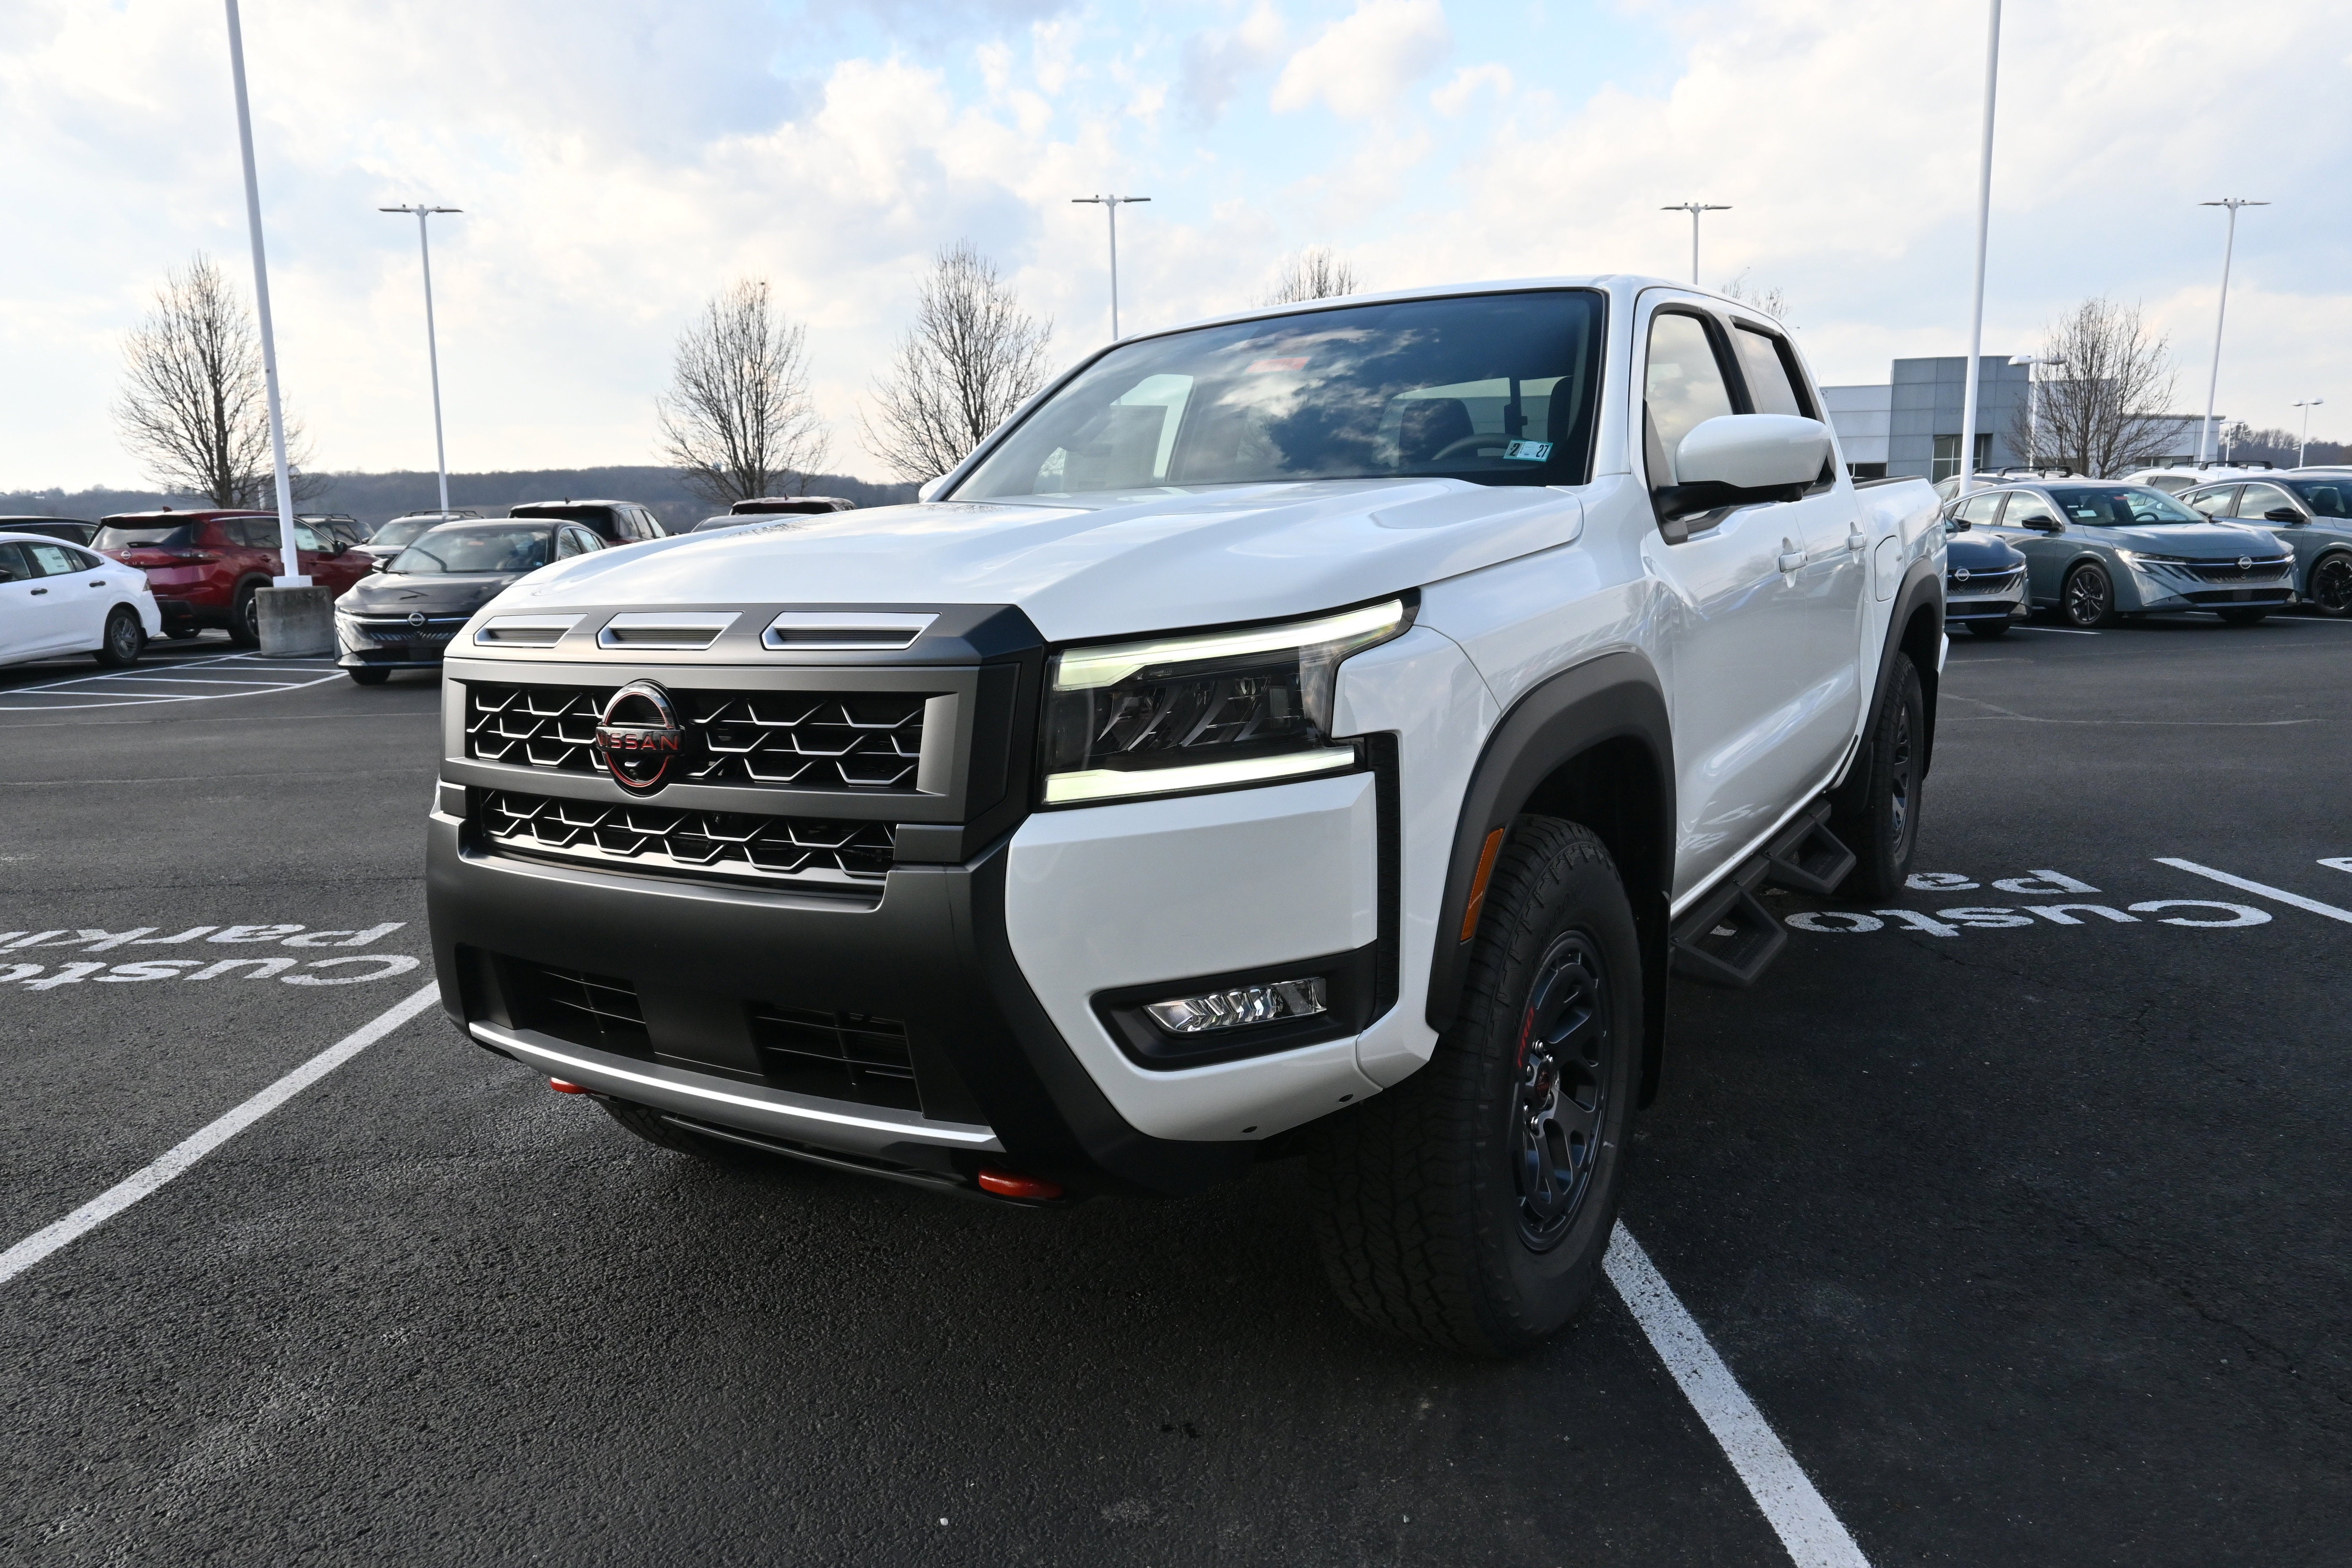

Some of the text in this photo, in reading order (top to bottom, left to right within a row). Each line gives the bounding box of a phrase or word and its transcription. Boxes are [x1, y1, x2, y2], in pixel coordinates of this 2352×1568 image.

[1509, 443, 1521, 456] 2
[1536, 445, 1549, 458] 27
[596, 732, 678, 750] NISSAN
[0, 922, 407, 954] Parki
[1518, 1007, 1534, 1068] PRO
